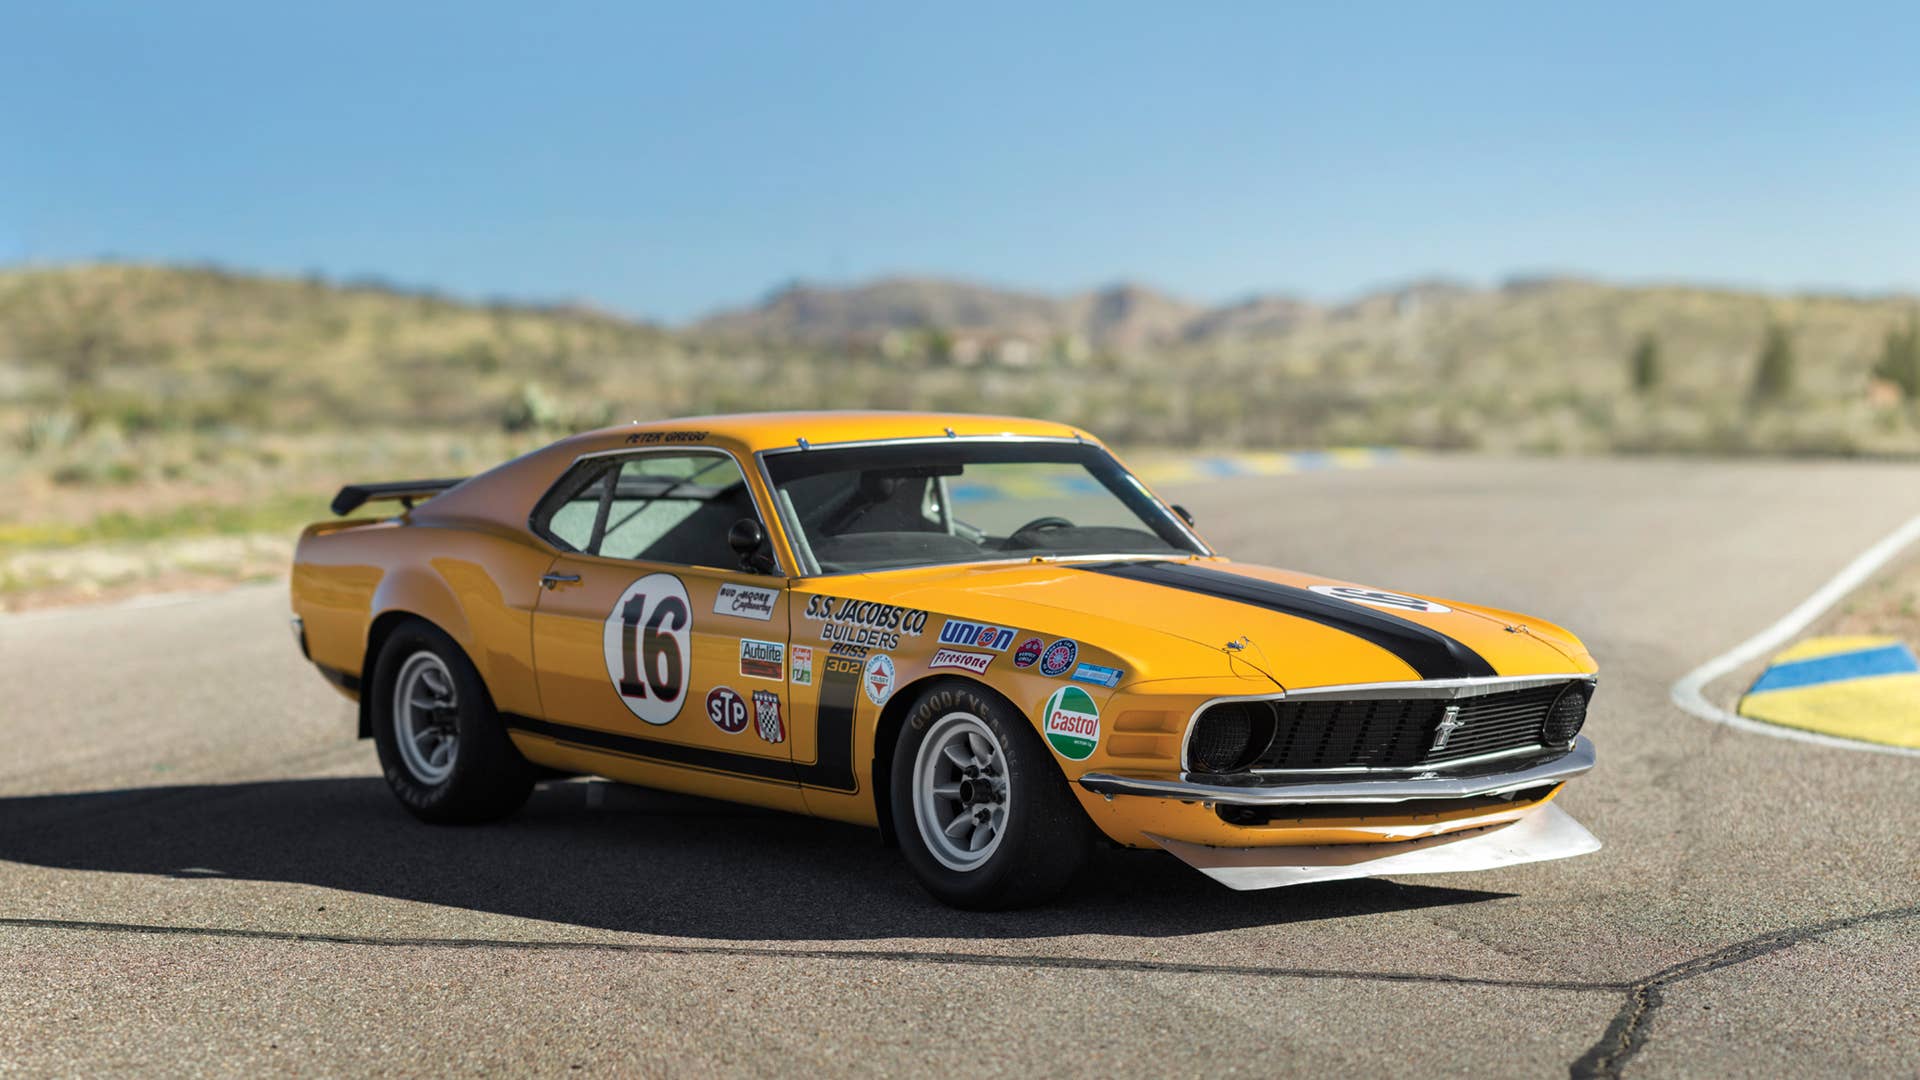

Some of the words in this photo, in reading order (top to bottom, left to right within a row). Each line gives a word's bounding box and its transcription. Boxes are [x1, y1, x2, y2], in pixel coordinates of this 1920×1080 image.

[720, 588, 737, 597] BUD
[805, 594, 836, 618] S.S.
[833, 598, 905, 630] JACOBS
[900, 608, 928, 635] CO.
[821, 623, 900, 651] BUILDERS
[982, 630, 997, 643] 76
[620, 593, 687, 702] 16
[743, 642, 782, 662] Autolite
[829, 642, 871, 659] BOSS
[827, 658, 861, 674] 302
[934, 650, 987, 669] Firestone
[711, 691, 745, 727] STP
[1051, 711, 1098, 737] Castrol
